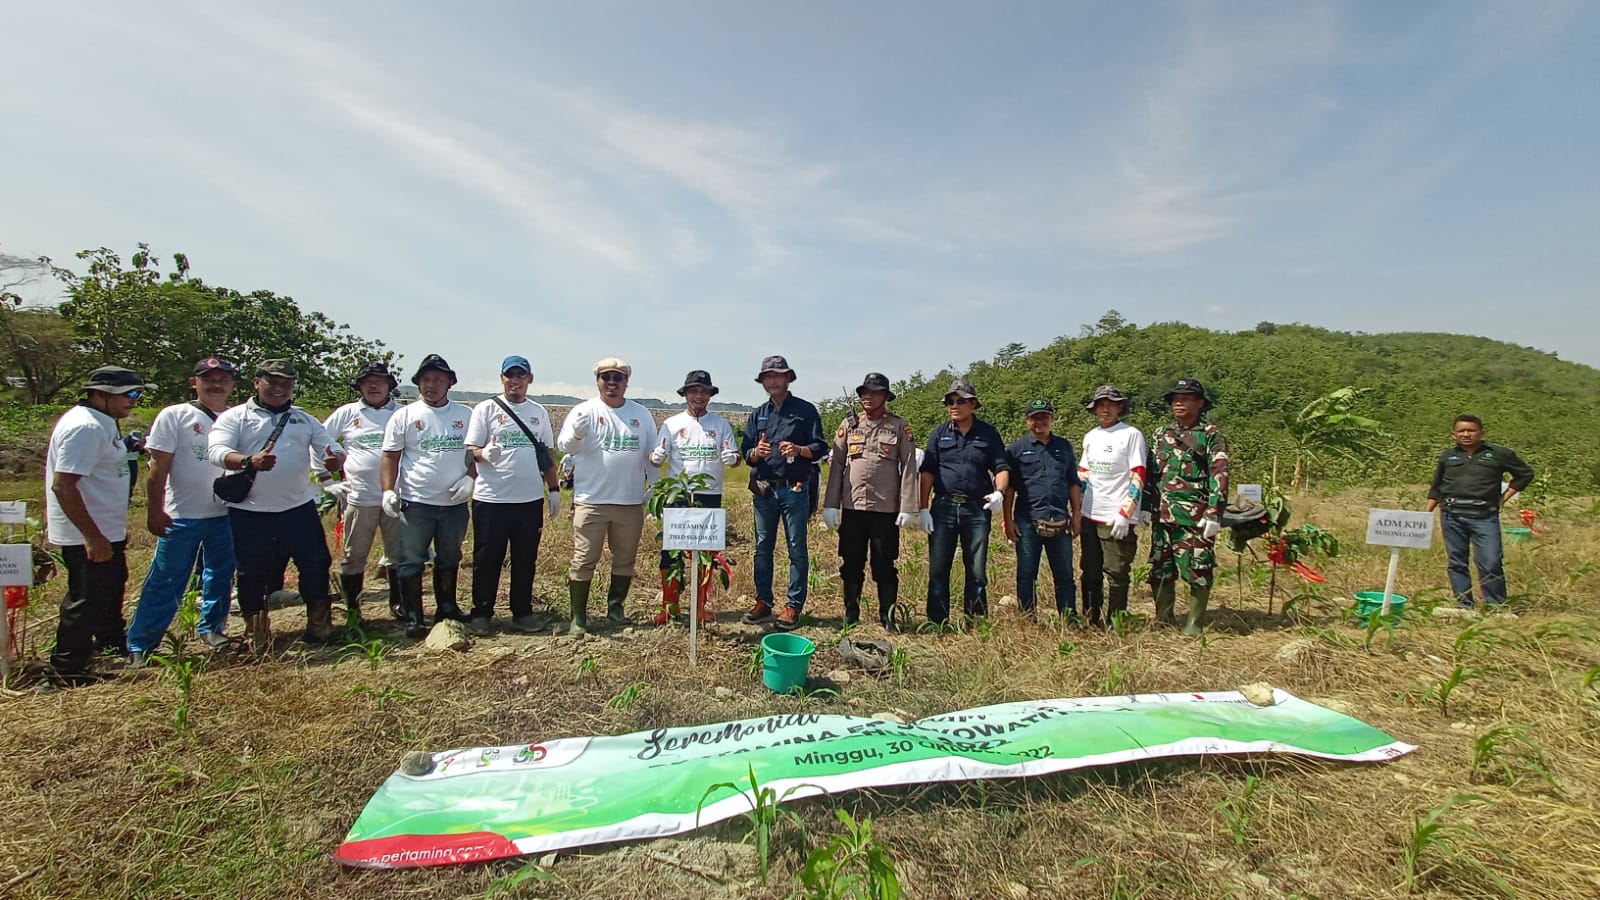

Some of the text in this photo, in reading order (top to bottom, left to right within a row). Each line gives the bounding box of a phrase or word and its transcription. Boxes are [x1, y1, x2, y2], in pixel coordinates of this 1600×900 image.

[1376, 519, 1427, 529] ADM KPH
[794, 747, 884, 766] Minggu,
[886, 739, 914, 755] 30
